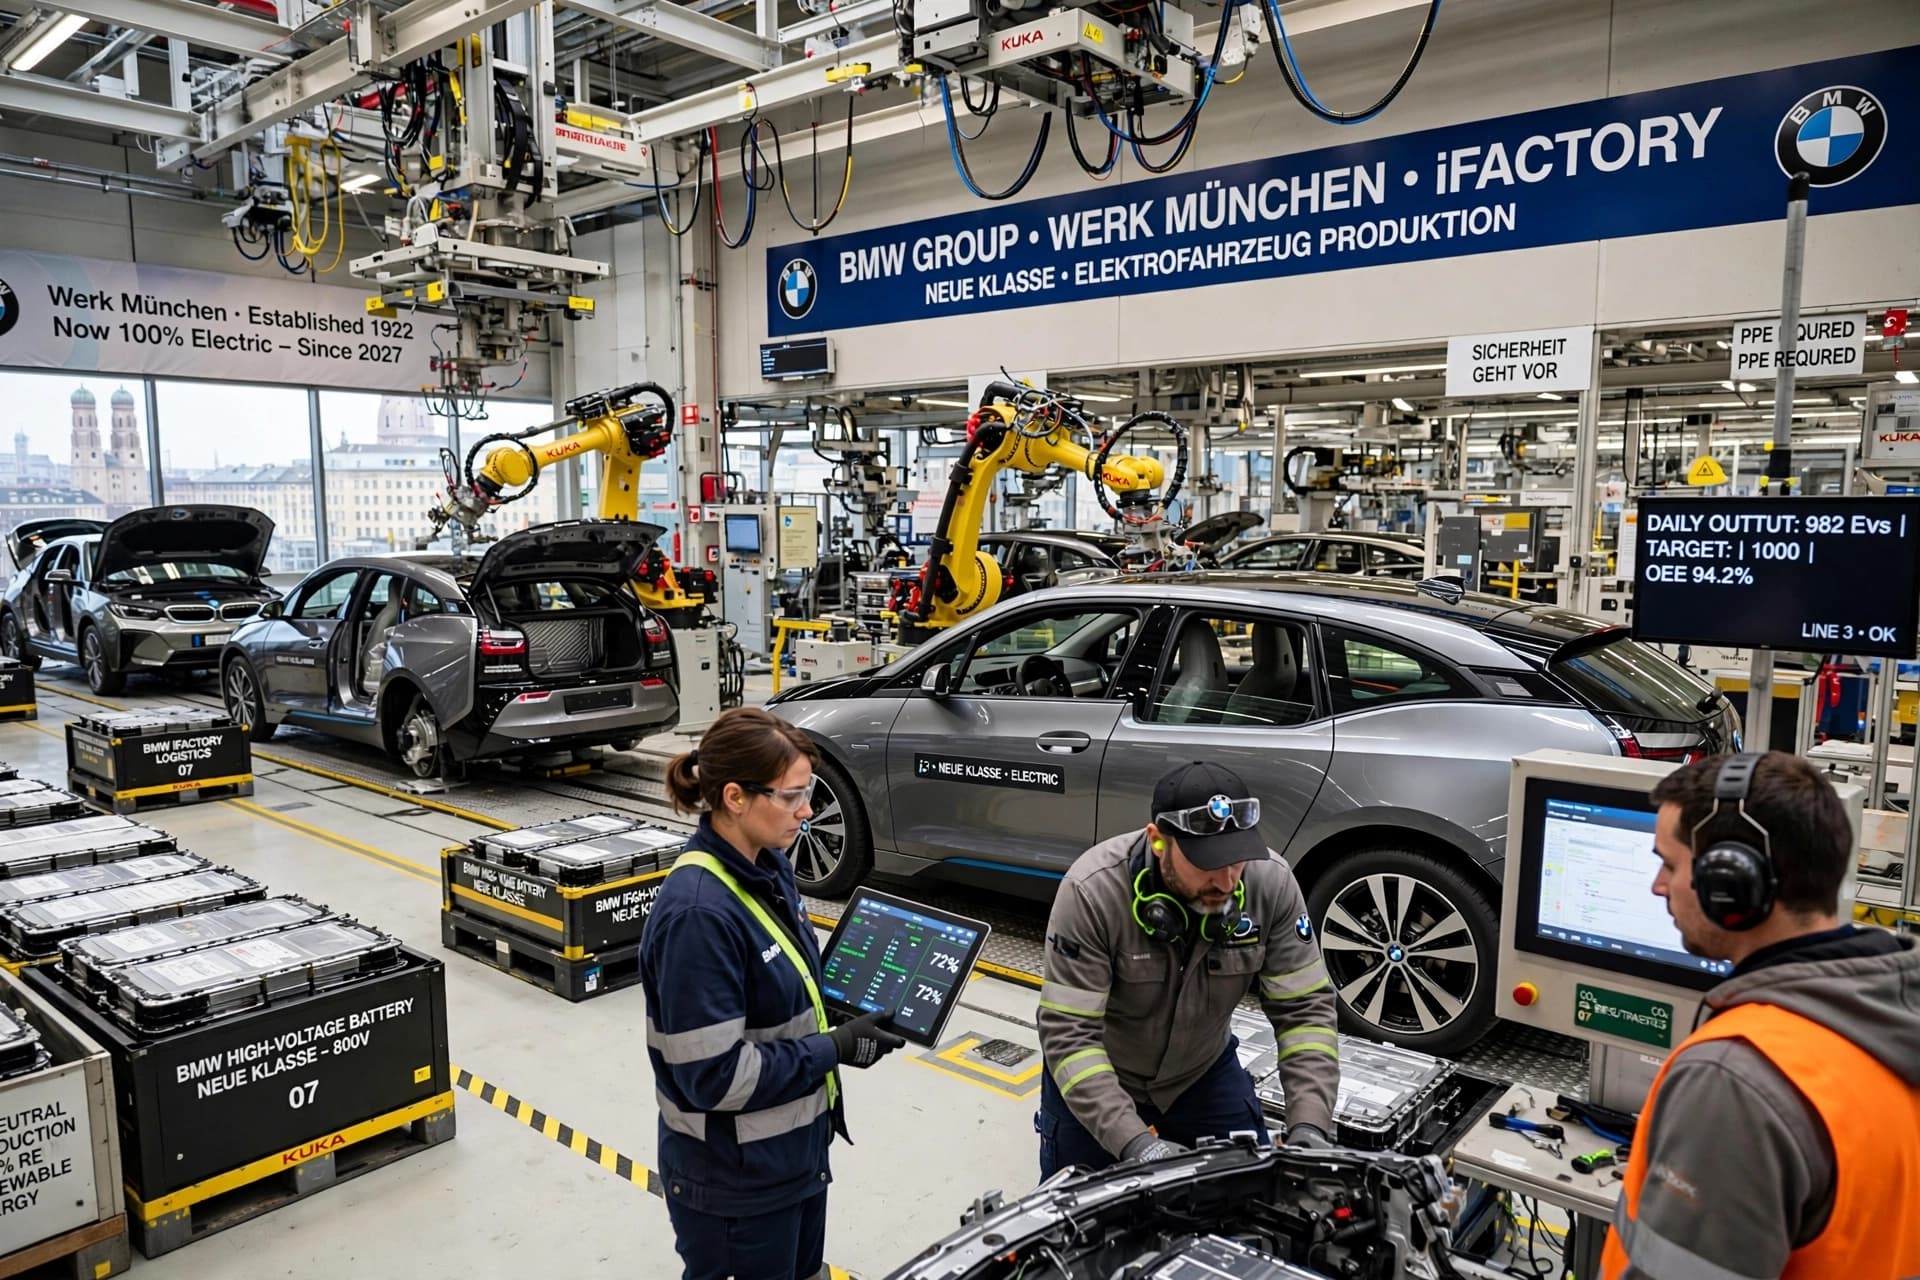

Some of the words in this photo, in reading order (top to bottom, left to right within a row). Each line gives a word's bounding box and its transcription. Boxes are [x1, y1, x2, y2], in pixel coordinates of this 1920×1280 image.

[1001, 30, 1043, 51] KUKA
[1789, 90, 1877, 125] BMW
[840, 242, 906, 284] BMW
[912, 223, 1019, 273] GROUP
[1048, 200, 1154, 251] WERK
[1165, 161, 1386, 235] MÜNCHEN
[1436, 107, 1724, 195] iFACTORY
[925, 278, 974, 305] NEUE
[979, 266, 1056, 298] KLASSE
[1075, 231, 1312, 286] ELEKTROFAHRZEUG
[1320, 203, 1517, 254] PRODUKTION
[47, 284, 114, 312] Werk
[121, 294, 228, 322] München
[249, 306, 364, 335] Established
[372, 320, 414, 340] 1922
[53, 316, 110, 340] Now
[119, 324, 184, 346] 100%
[192, 329, 272, 353] Electric
[297, 338, 353, 360] Since
[358, 344, 403, 364] 2027
[1741, 326, 1774, 344] PPE
[1780, 321, 1855, 342] QURED
[1472, 338, 1567, 361] SICHERHEIT
[1738, 352, 1770, 369] PPE
[1774, 347, 1856, 367] REQURED
[1473, 365, 1517, 383] GEHT
[1522, 362, 1558, 380] VOR
[1879, 432, 1920, 443] KUKA
[546, 441, 581, 457] KUKA
[1647, 514, 1704, 532] DAILY
[1709, 514, 1799, 533] OUTTUT:
[1805, 515, 1844, 534] 982
[1850, 515, 1891, 534] Evs
[1646, 540, 1733, 558] TARGET:
[1752, 542, 1800, 560] 1000
[1645, 565, 1687, 583] OEE
[1692, 567, 1754, 584] 94.2%
[1802, 623, 1839, 639] LINE
[1842, 626, 1853, 639] 3
[1868, 627, 1896, 643] OK
[143, 741, 170, 754] BMW
[155, 748, 212, 764] LOGISTICS
[178, 764, 194, 777] 07
[938, 762, 964, 776] NEUE
[965, 765, 1002, 780] KLASSE
[1011, 769, 1059, 786] ELECTRIC
[595, 895, 621, 913] BMW
[612, 904, 640, 924] NEUE
[929, 952, 960, 974] 72%
[915, 984, 943, 1005] 72%
[176, 1053, 223, 1083] BMW
[227, 1017, 346, 1067] HIGH-VOLTAGE
[349, 998, 414, 1030] BATTERY
[197, 1069, 248, 1099] NEUE
[252, 1046, 318, 1082] KLASSE
[333, 1030, 370, 1055] 800V
[289, 1080, 320, 1109] 07
[19, 1148, 43, 1168] RE
[282, 1134, 346, 1166] KUKA
[0, 1189, 39, 1216] RGY
